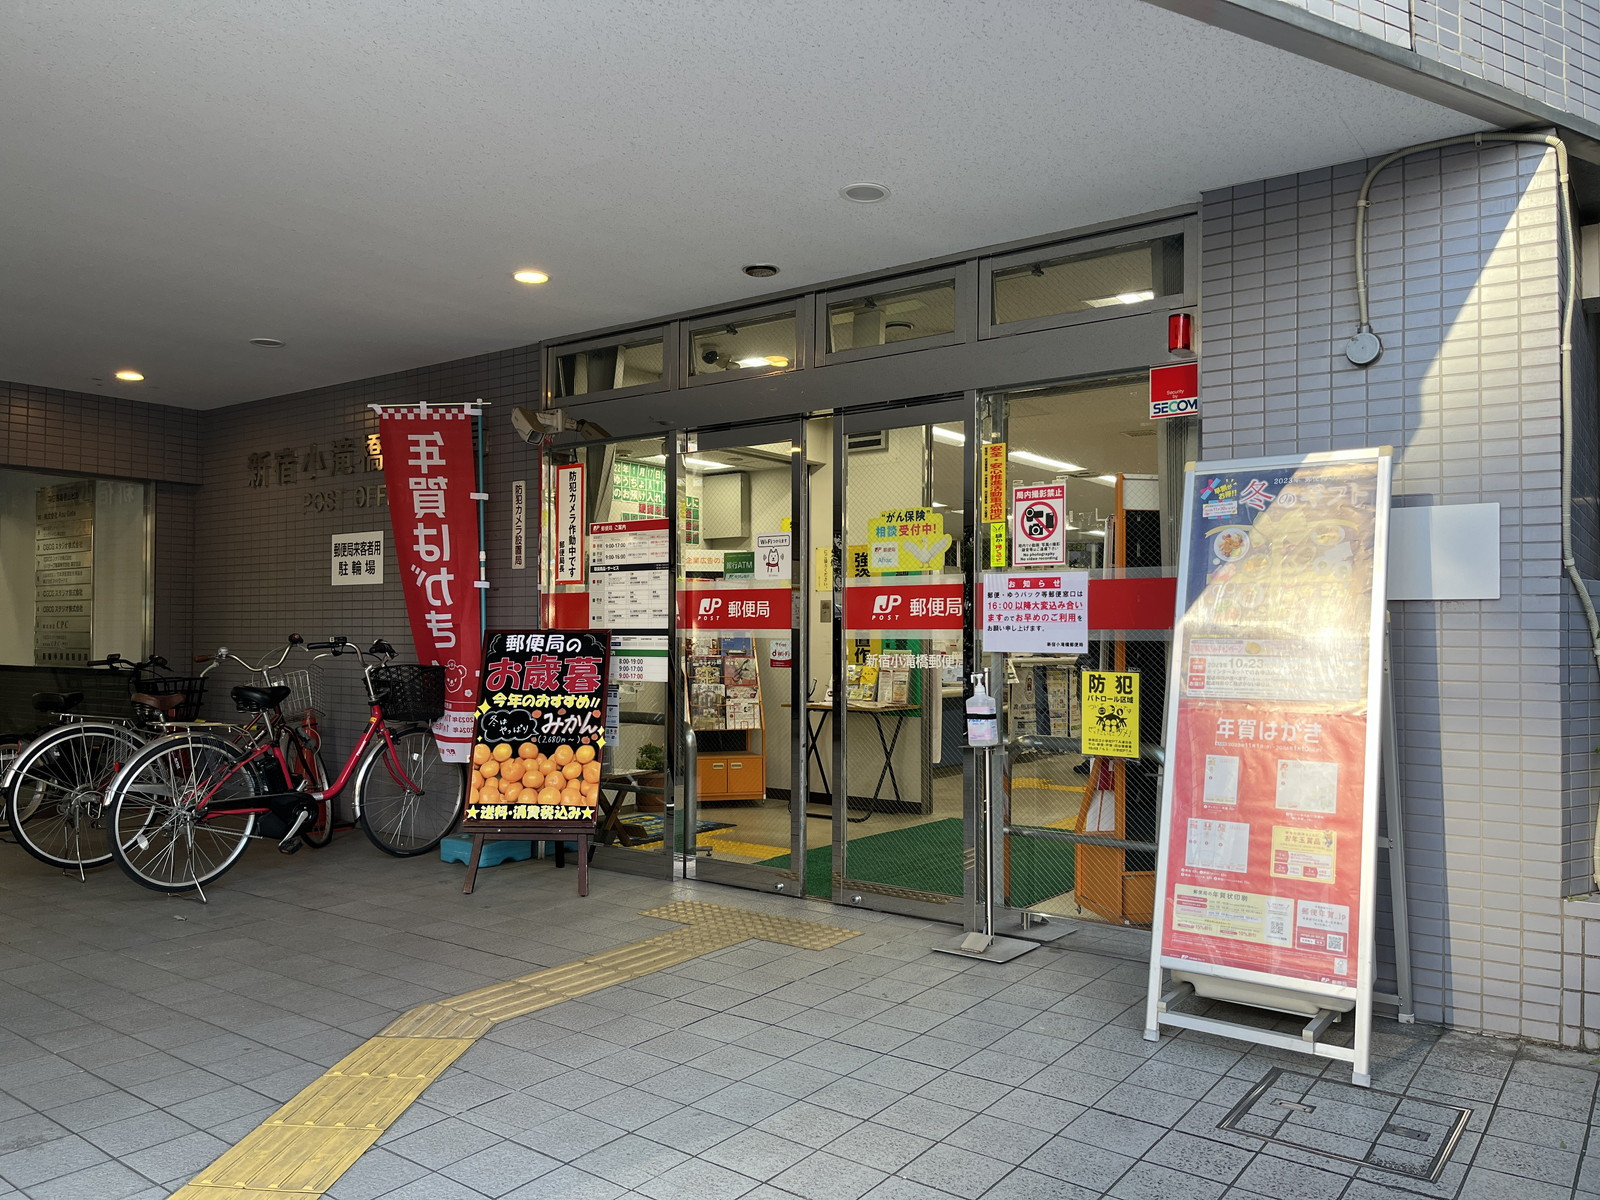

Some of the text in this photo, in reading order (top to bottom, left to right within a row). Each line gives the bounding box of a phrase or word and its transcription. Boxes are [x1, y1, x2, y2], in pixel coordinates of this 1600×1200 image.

[1153, 399, 1198, 414] SECOM
[1016, 489, 1062, 499] 局内撮影禁止
[569, 471, 577, 577] 防犯カメラ作動中です
[876, 524, 937, 538] 相談受付中!
[333, 541, 381, 557] 郵便局来客者用
[338, 560, 376, 576] 駐輪場
[685, 557, 724, 565] 企業広告の
[1008, 580, 1060, 588] お知らせ
[987, 591, 1083, 599] 郵便・ゆうパック等郵便窓口は
[728, 600, 770, 618] 郵便局
[909, 597, 963, 617] 郵便局
[987, 613, 1083, 622] ますのでお早めのご利用を
[506, 634, 582, 653] 郵便局の
[486, 654, 602, 693] お歳暮
[1089, 674, 1133, 695] 防犯
[1088, 695, 1133, 703] パトロール区域
[541, 711, 598, 735] みかん
[1216, 718, 1322, 744] 年賀はがき
[480, 805, 581, 820] 送料・消費税込み
